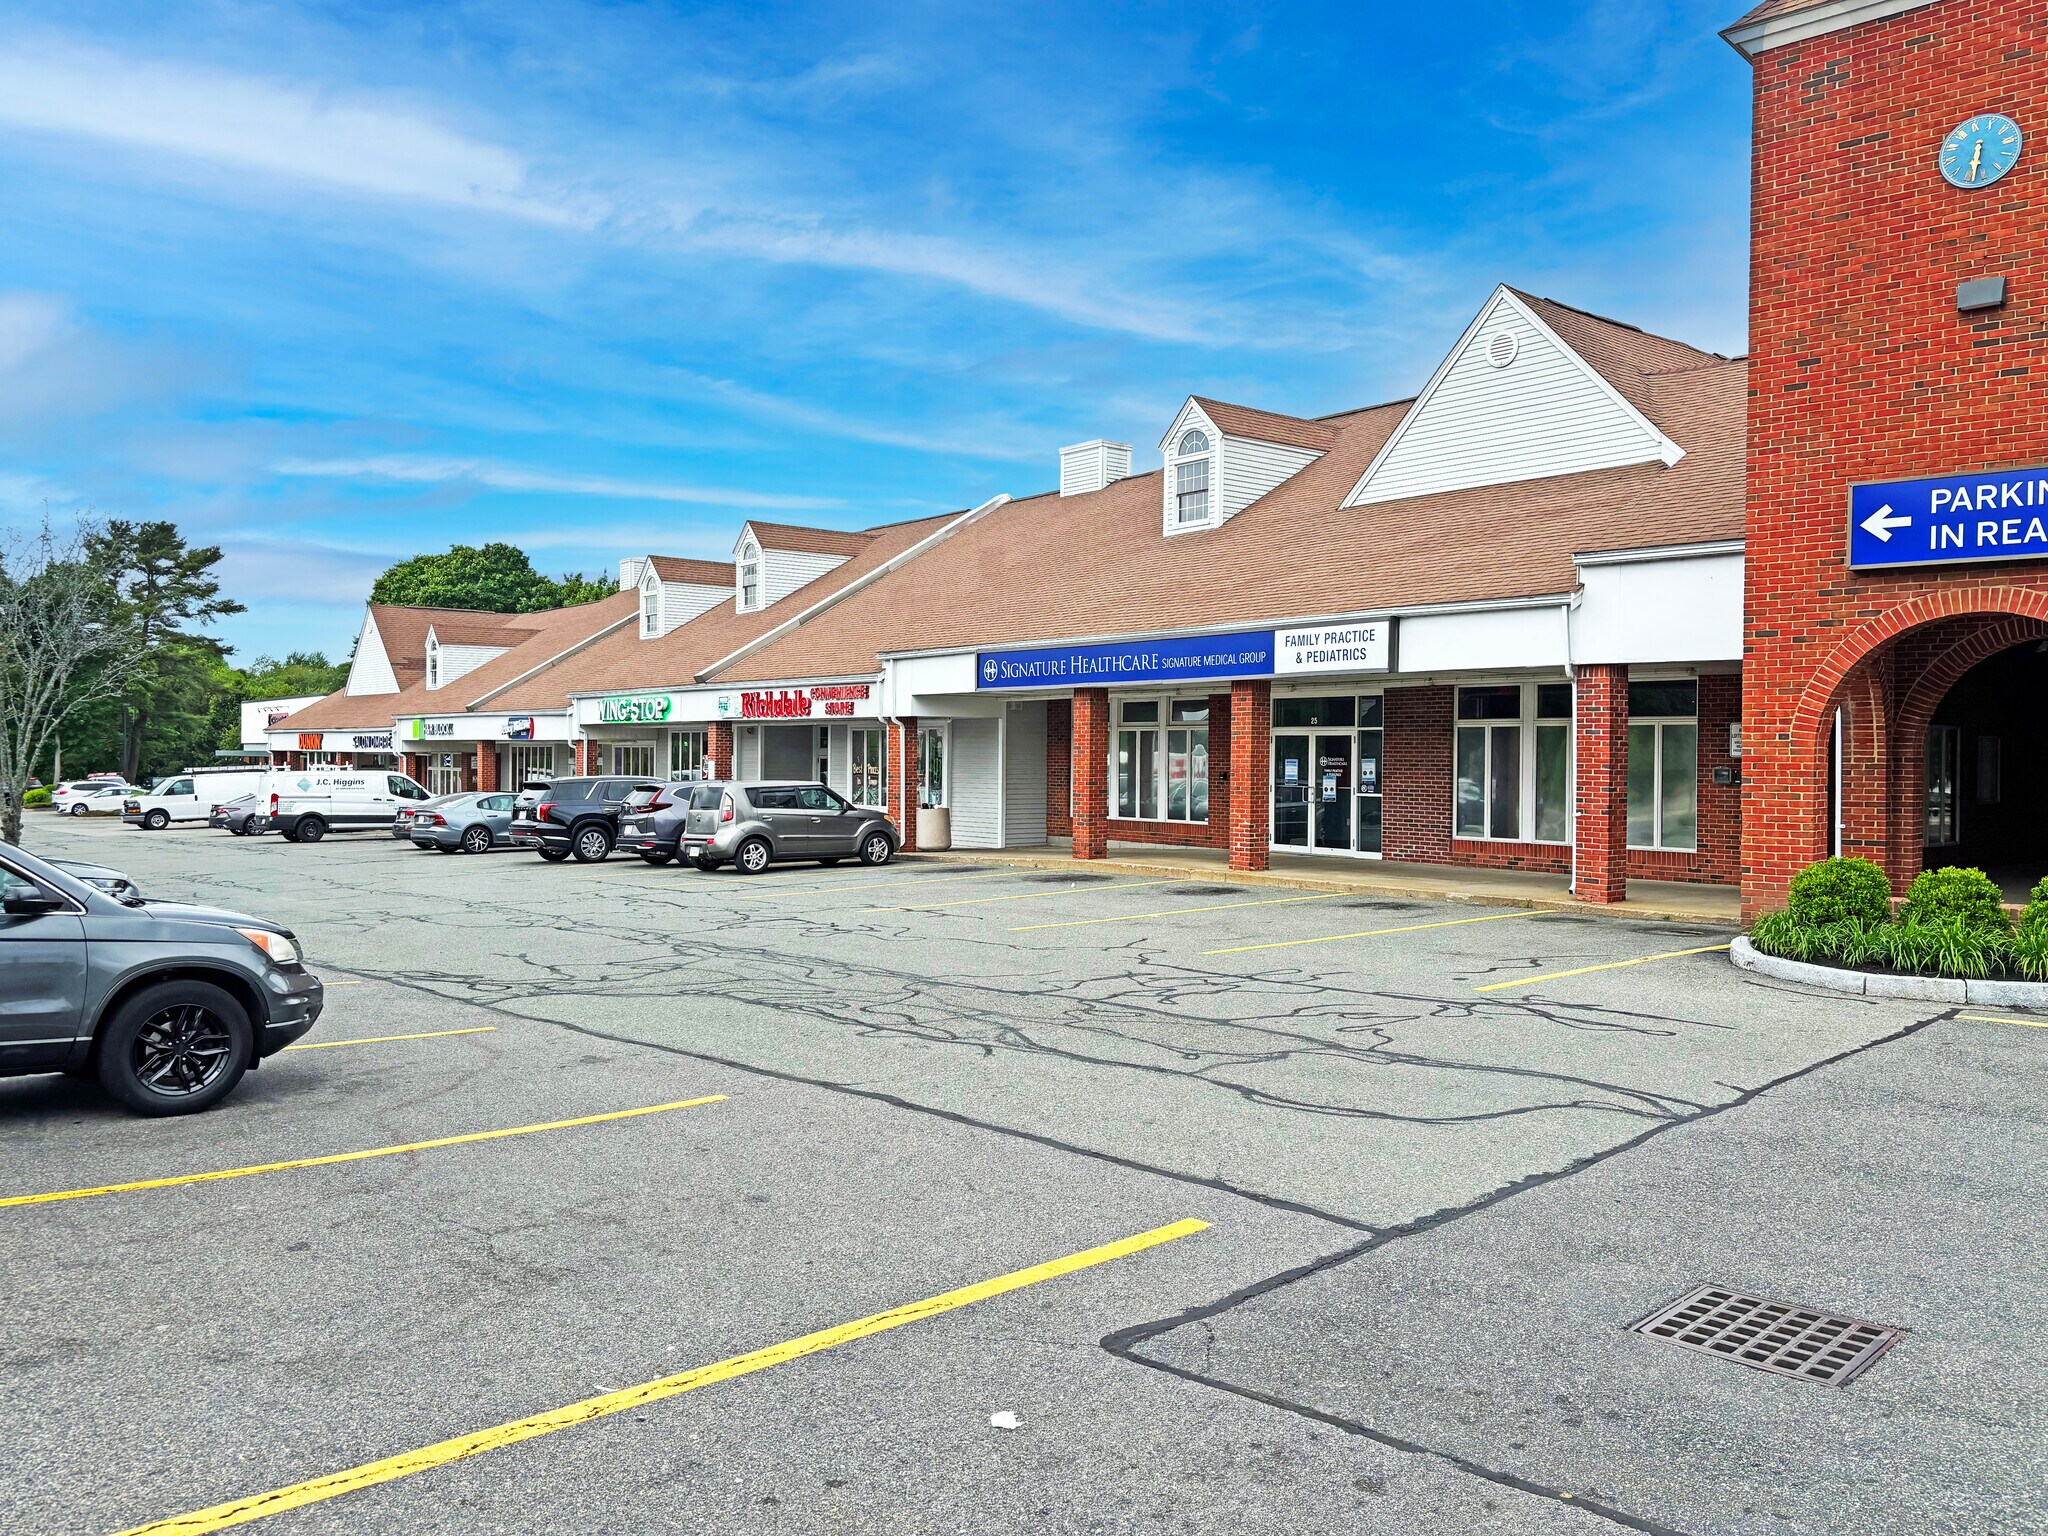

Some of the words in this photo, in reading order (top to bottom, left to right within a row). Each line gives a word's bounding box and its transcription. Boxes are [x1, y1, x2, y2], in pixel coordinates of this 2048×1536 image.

[1930, 523, 1964, 550] IN
[1977, 517, 2048, 546] REA
[1285, 633, 1320, 648] FAMILY
[1324, 628, 1376, 644] PRACTICE
[1295, 652, 1303, 664] &
[1306, 647, 1367, 663] PEDIATRICS
[1000, 660, 1067, 679] SIGNATURE
[1070, 653, 1159, 675] HEALTHCARE
[1161, 654, 1202, 669] SIGNATURE
[1203, 652, 1237, 667] MEDICAL
[1239, 651, 1267, 665] GROUP
[810, 685, 869, 700] CONVENIENCE
[825, 701, 854, 716] STORE
[1310, 716, 1318, 725] 25
[316, 778, 331, 786] J.C.
[333, 778, 365, 787] Higgins
